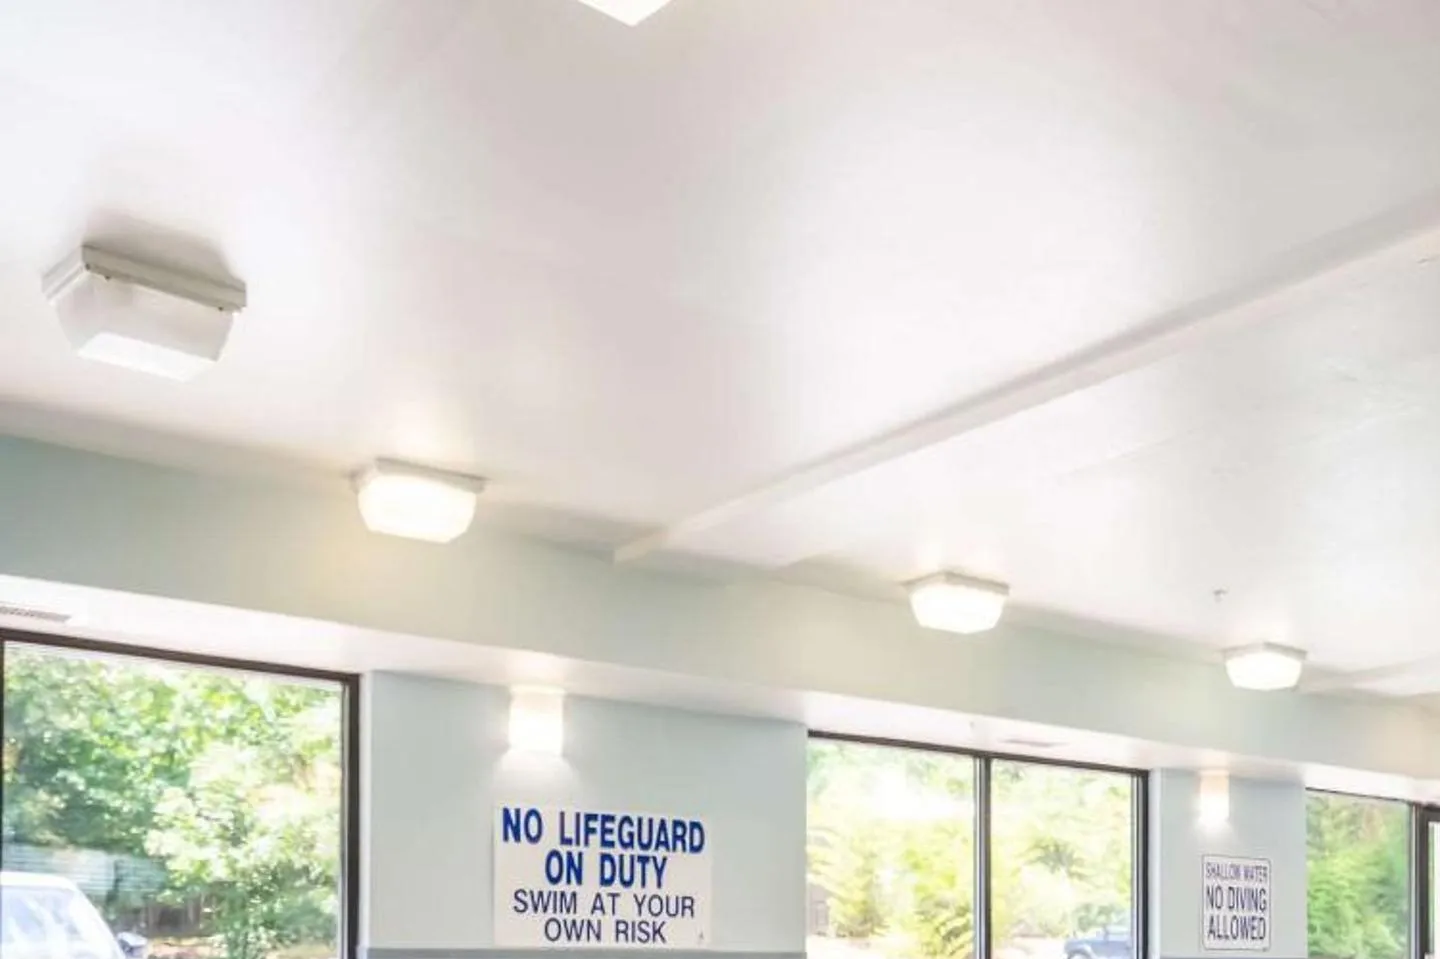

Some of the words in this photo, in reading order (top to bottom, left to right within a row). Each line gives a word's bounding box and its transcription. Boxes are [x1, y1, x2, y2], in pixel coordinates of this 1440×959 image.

[502, 807, 543, 844] NO
[559, 811, 705, 853] LIFEGUARD
[545, 849, 583, 885] ON
[600, 853, 667, 889] DUTY
[513, 888, 577, 915] SWIM
[590, 892, 621, 916] AT
[633, 893, 695, 918] YOUR
[1206, 885, 1223, 910] NO
[1228, 886, 1267, 912] DIVING
[544, 917, 601, 942] OWN
[615, 920, 667, 943] RISK
[1207, 915, 1266, 940] ALLOWED
